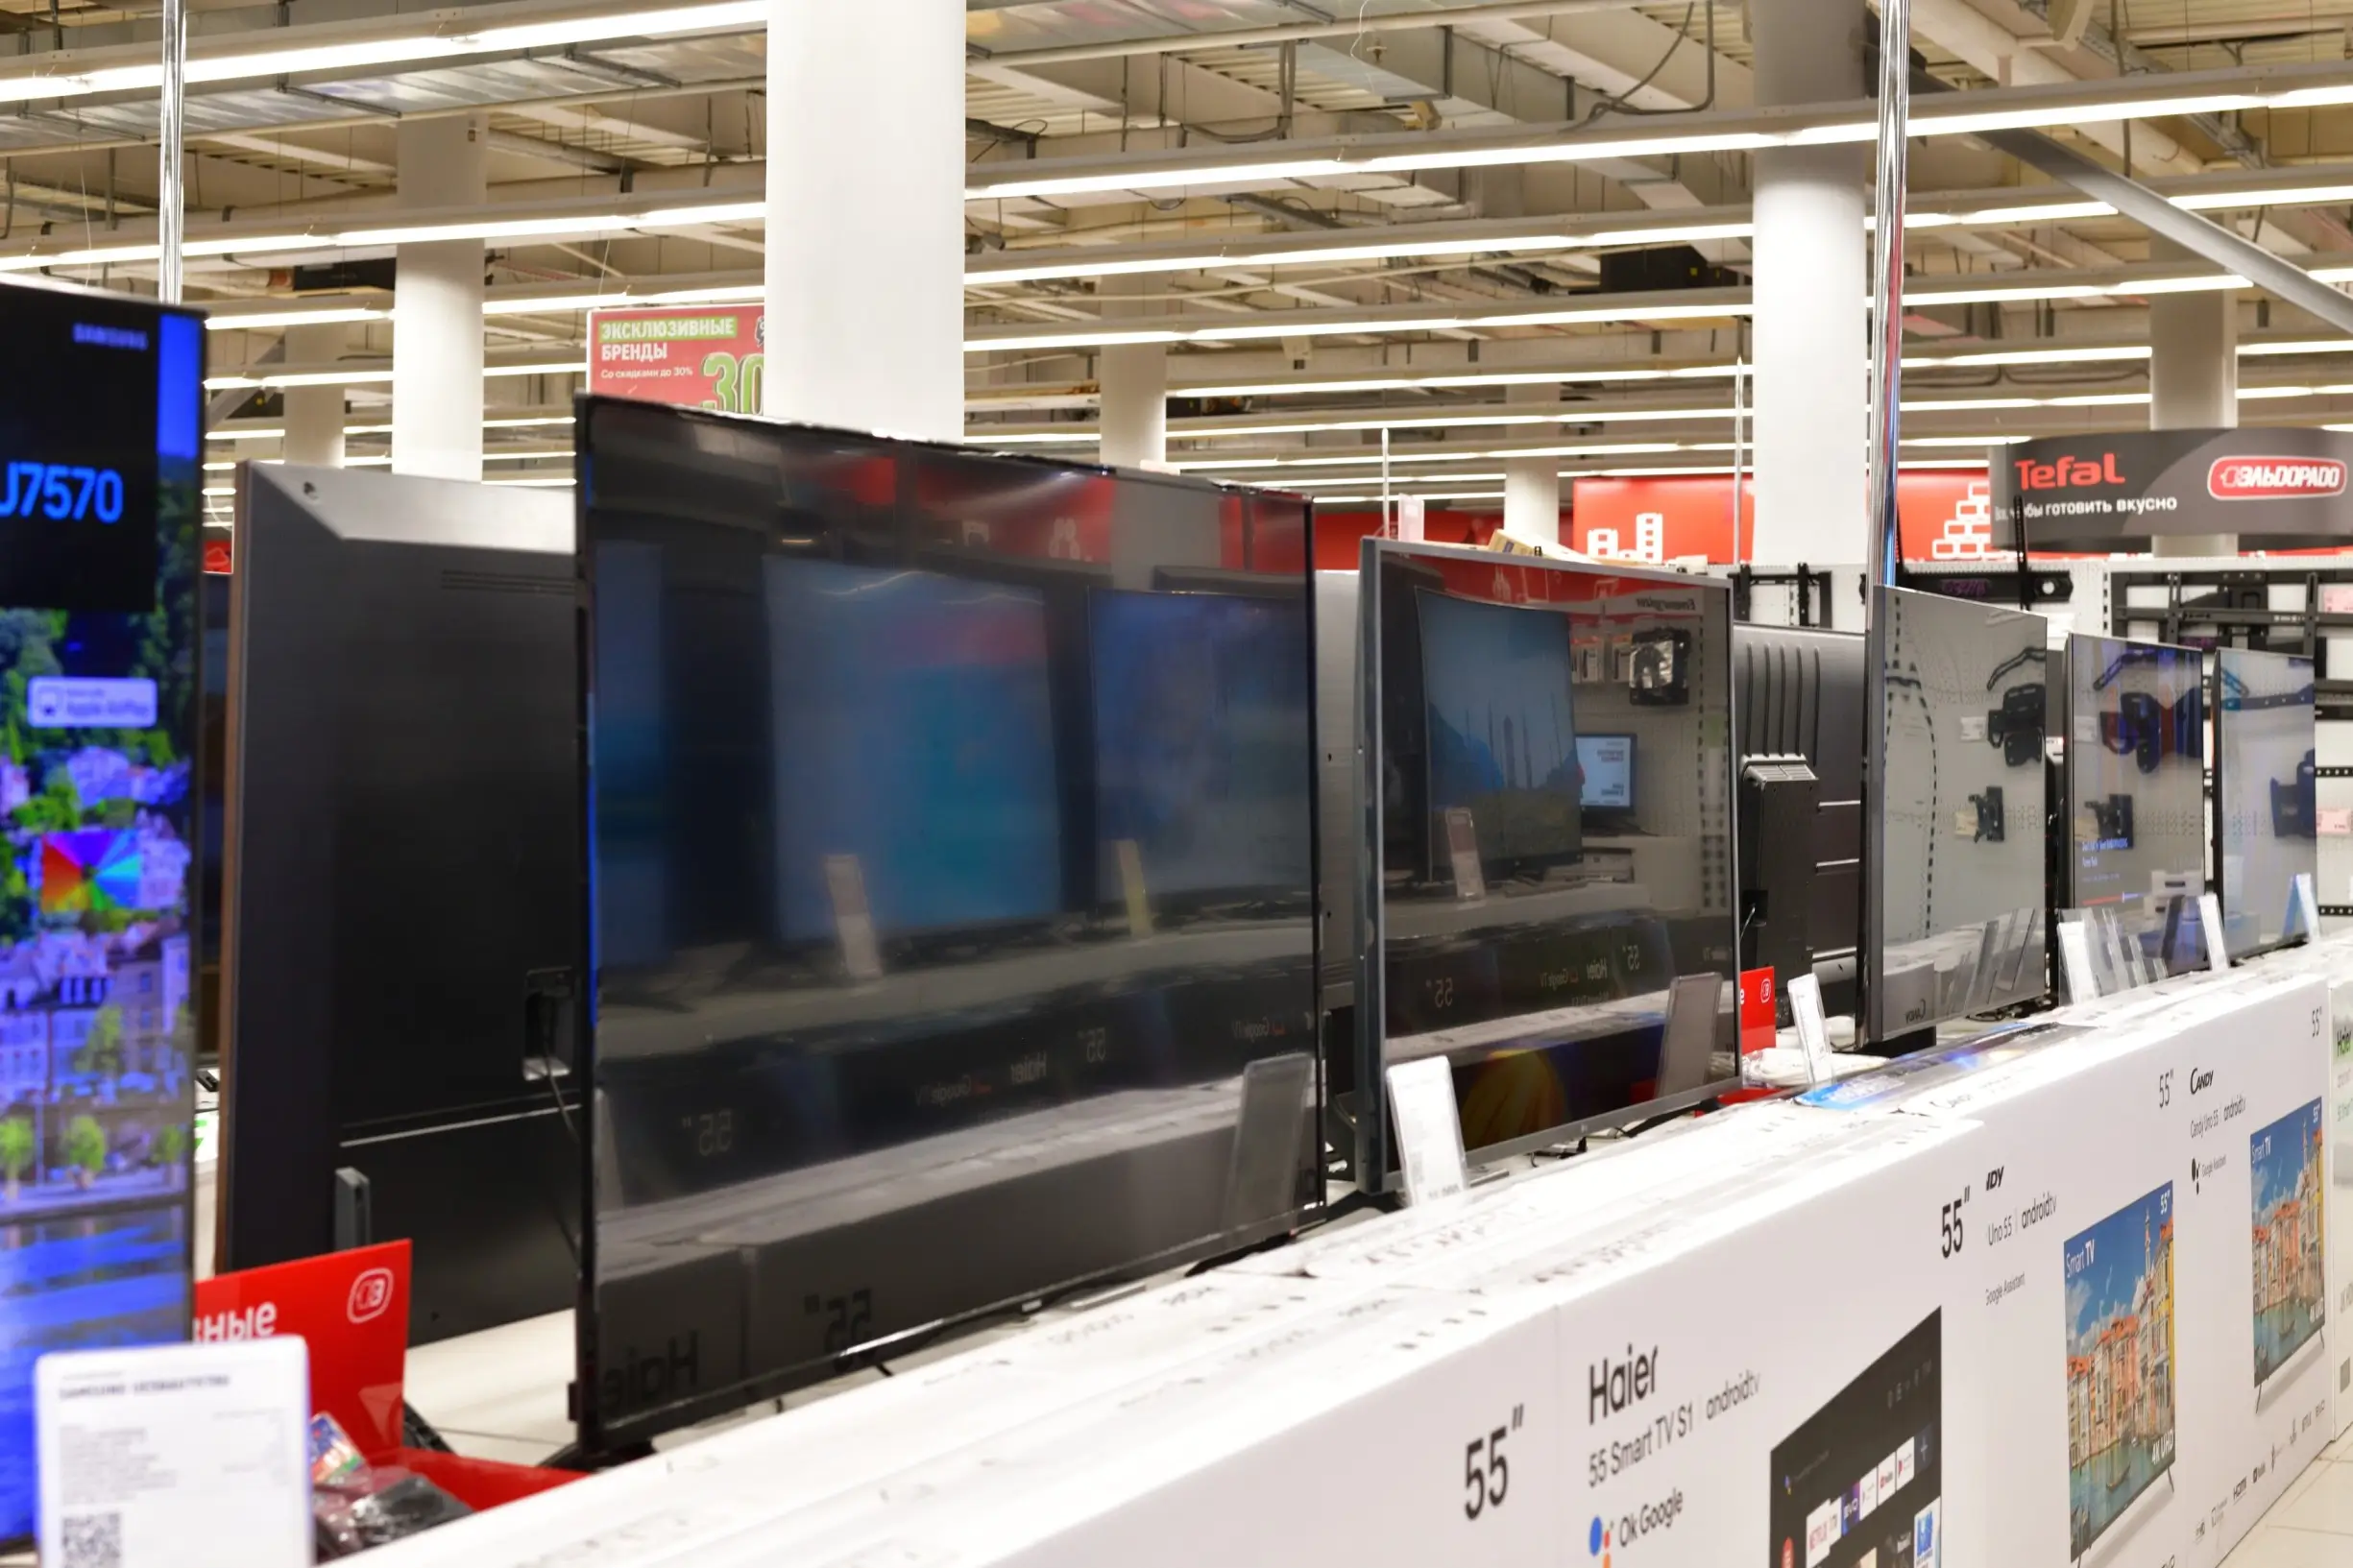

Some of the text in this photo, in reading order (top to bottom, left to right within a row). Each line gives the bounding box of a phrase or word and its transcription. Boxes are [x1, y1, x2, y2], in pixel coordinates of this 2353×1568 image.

[602, 318, 735, 340] ЭКСКЛЮЗИВНЫЕ
[601, 342, 667, 362] БРЕНДЫ
[600, 367, 693, 379] Со скидками до 30%
[2015, 453, 2125, 491] Tefal
[2046, 500, 2112, 517] готовить
[2117, 496, 2177, 515] вкусно
[2312, 1005, 2323, 1039] 55"
[2159, 1068, 2174, 1109] 55"
[2251, 1134, 2271, 1165] Smart TV
[2159, 1189, 2171, 1216] 55"
[1941, 1184, 1972, 1261] 55"
[1987, 1223, 2003, 1247] Uno
[2003, 1214, 2013, 1240] 55
[2066, 1238, 2095, 1279] Smart TV
[1589, 1342, 1659, 1427] Haier
[1589, 1368, 1761, 1488] 55 Smart TV S1 androidtv
[2151, 1428, 2174, 1465] 4K UHD
[1465, 1402, 1524, 1521] 55"
[1619, 1486, 1684, 1548] Ok Google
